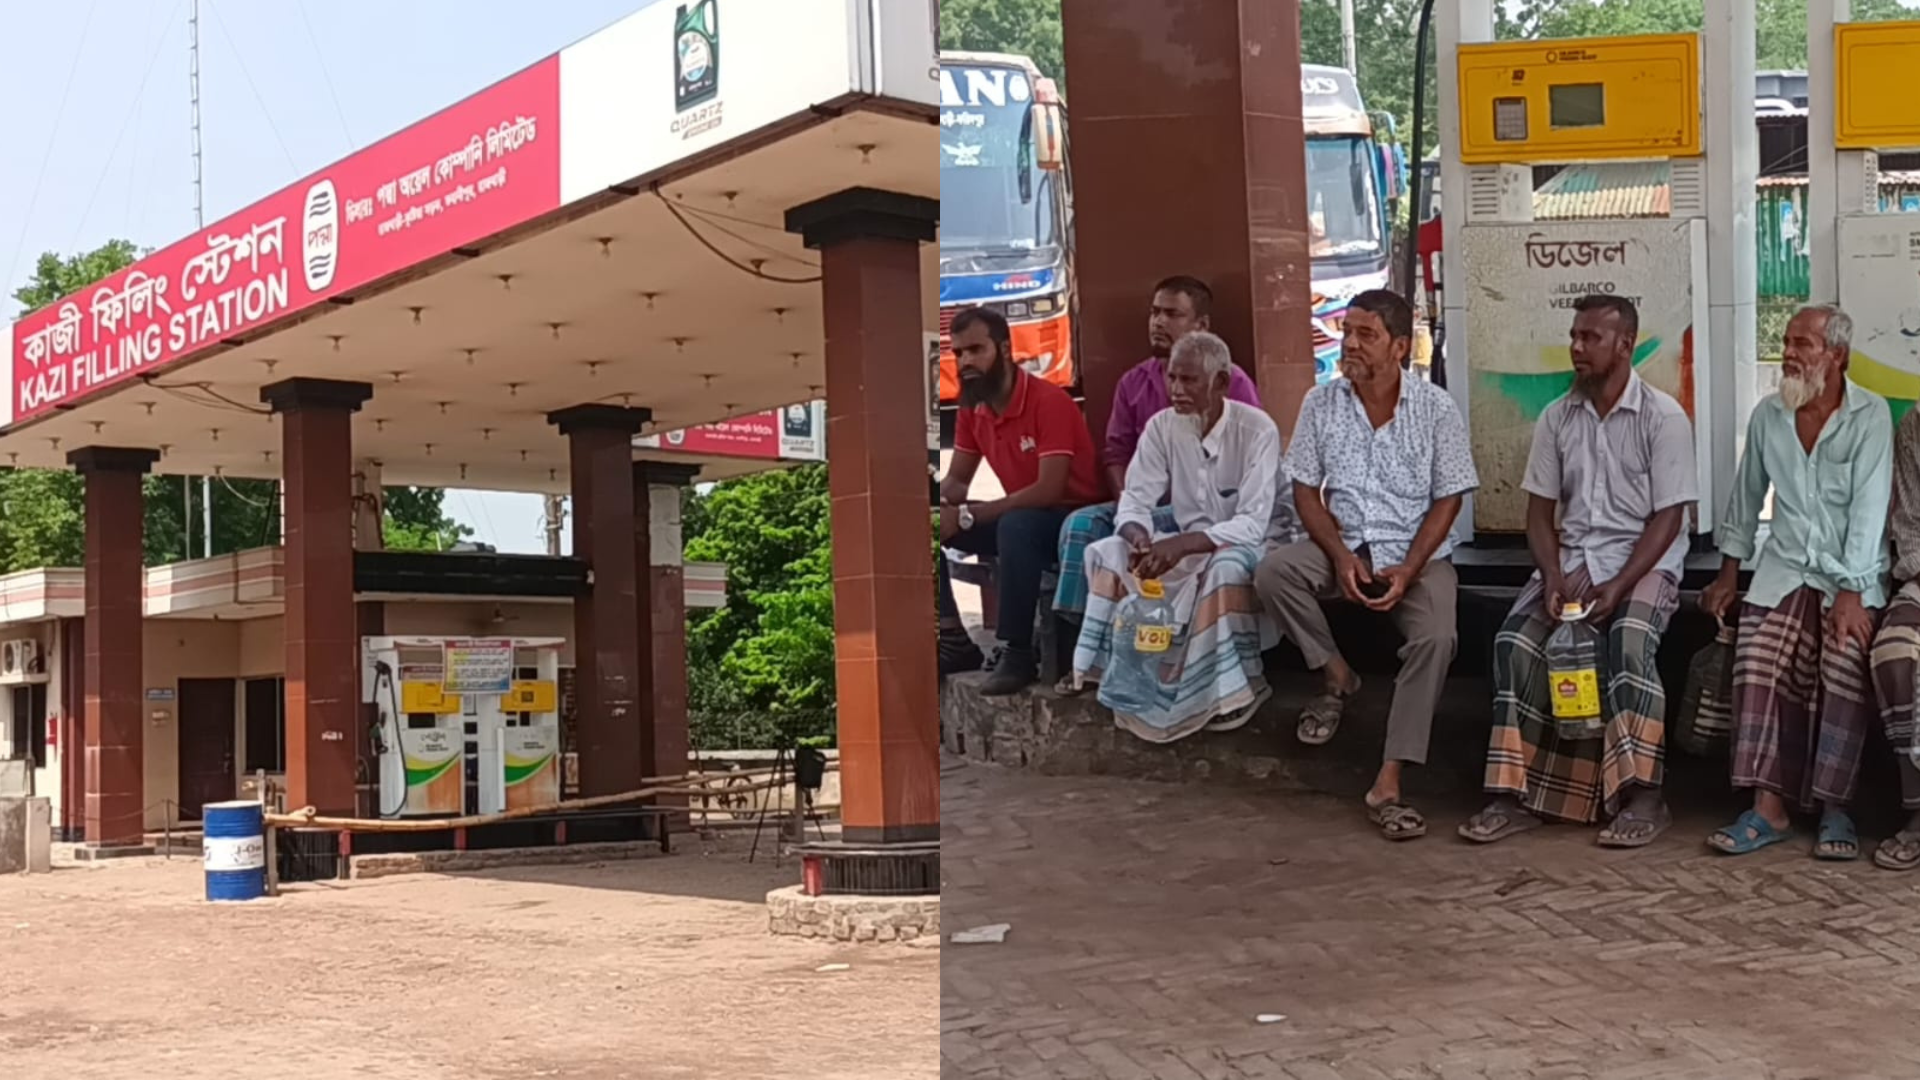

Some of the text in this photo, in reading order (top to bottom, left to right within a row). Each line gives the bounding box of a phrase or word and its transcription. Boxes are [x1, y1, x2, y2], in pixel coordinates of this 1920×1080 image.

[670, 101, 723, 133] QUARTZ
[22, 216, 286, 368] কাজী ফিলিং স্টেশন
[1525, 232, 1628, 268] ডিজেল
[20, 268, 288, 412] KAZI FILLING STATION
